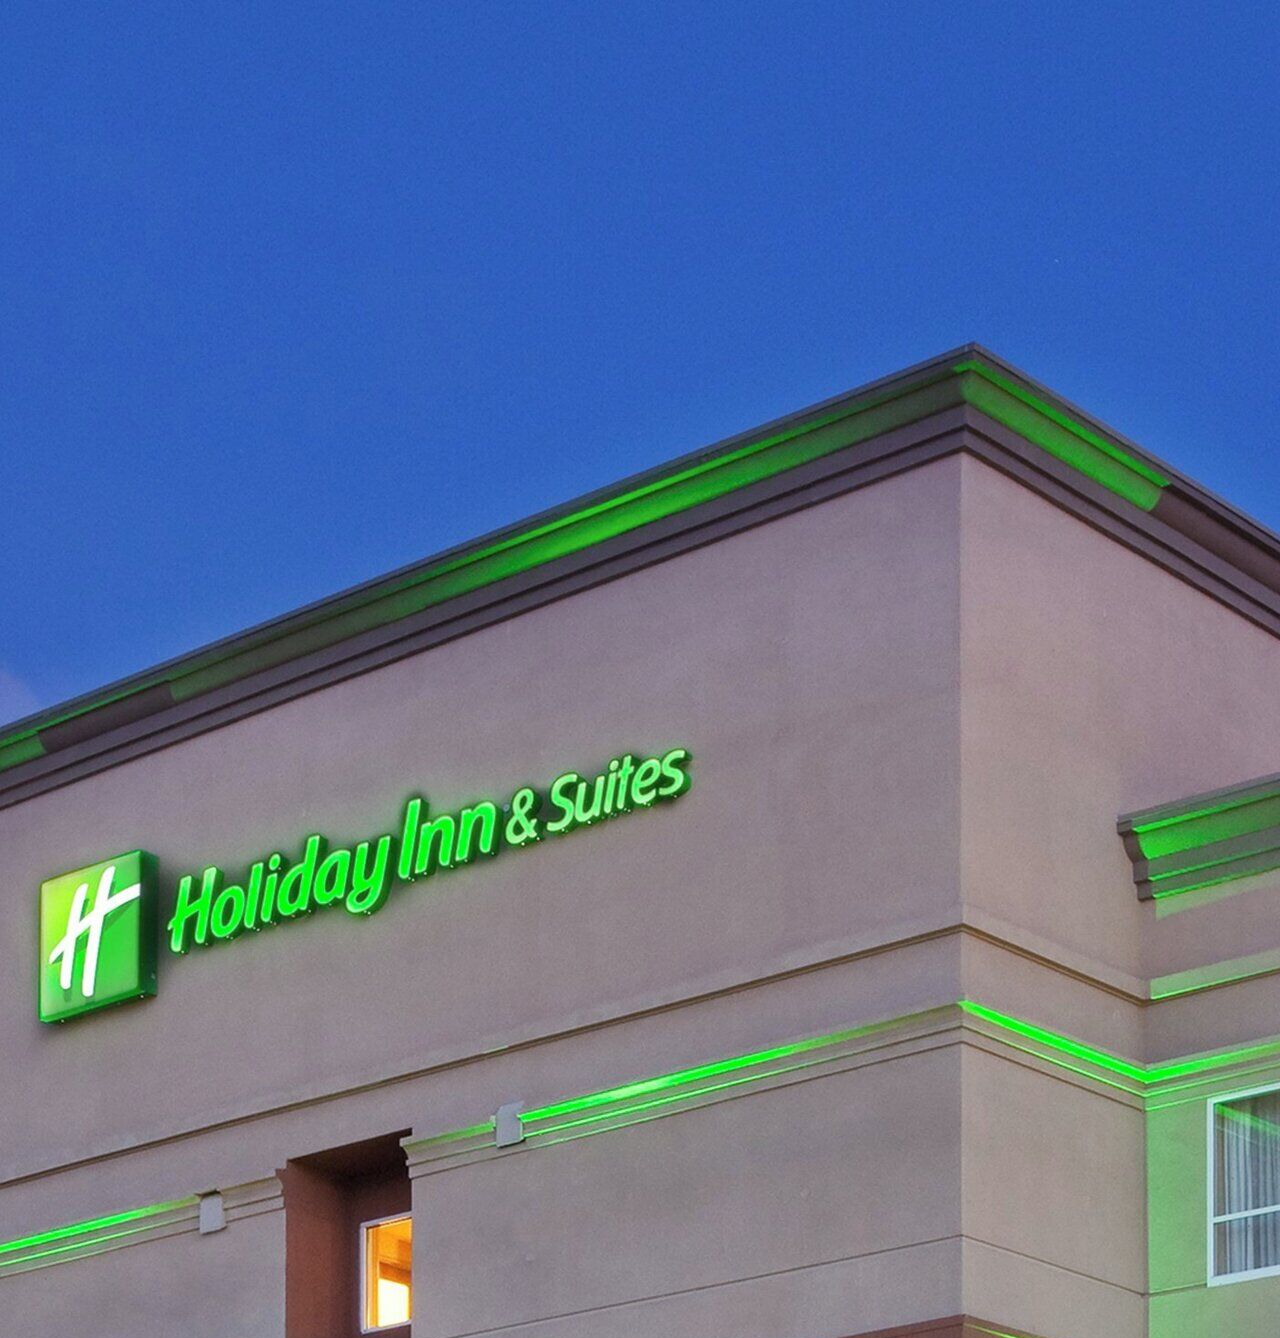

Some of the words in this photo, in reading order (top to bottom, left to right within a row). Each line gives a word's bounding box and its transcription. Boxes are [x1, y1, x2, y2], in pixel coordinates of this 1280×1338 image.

[168, 834, 391, 952] Holiday
[398, 798, 497, 879] Inn
[505, 787, 538, 845] &
[546, 749, 687, 833] Suites
